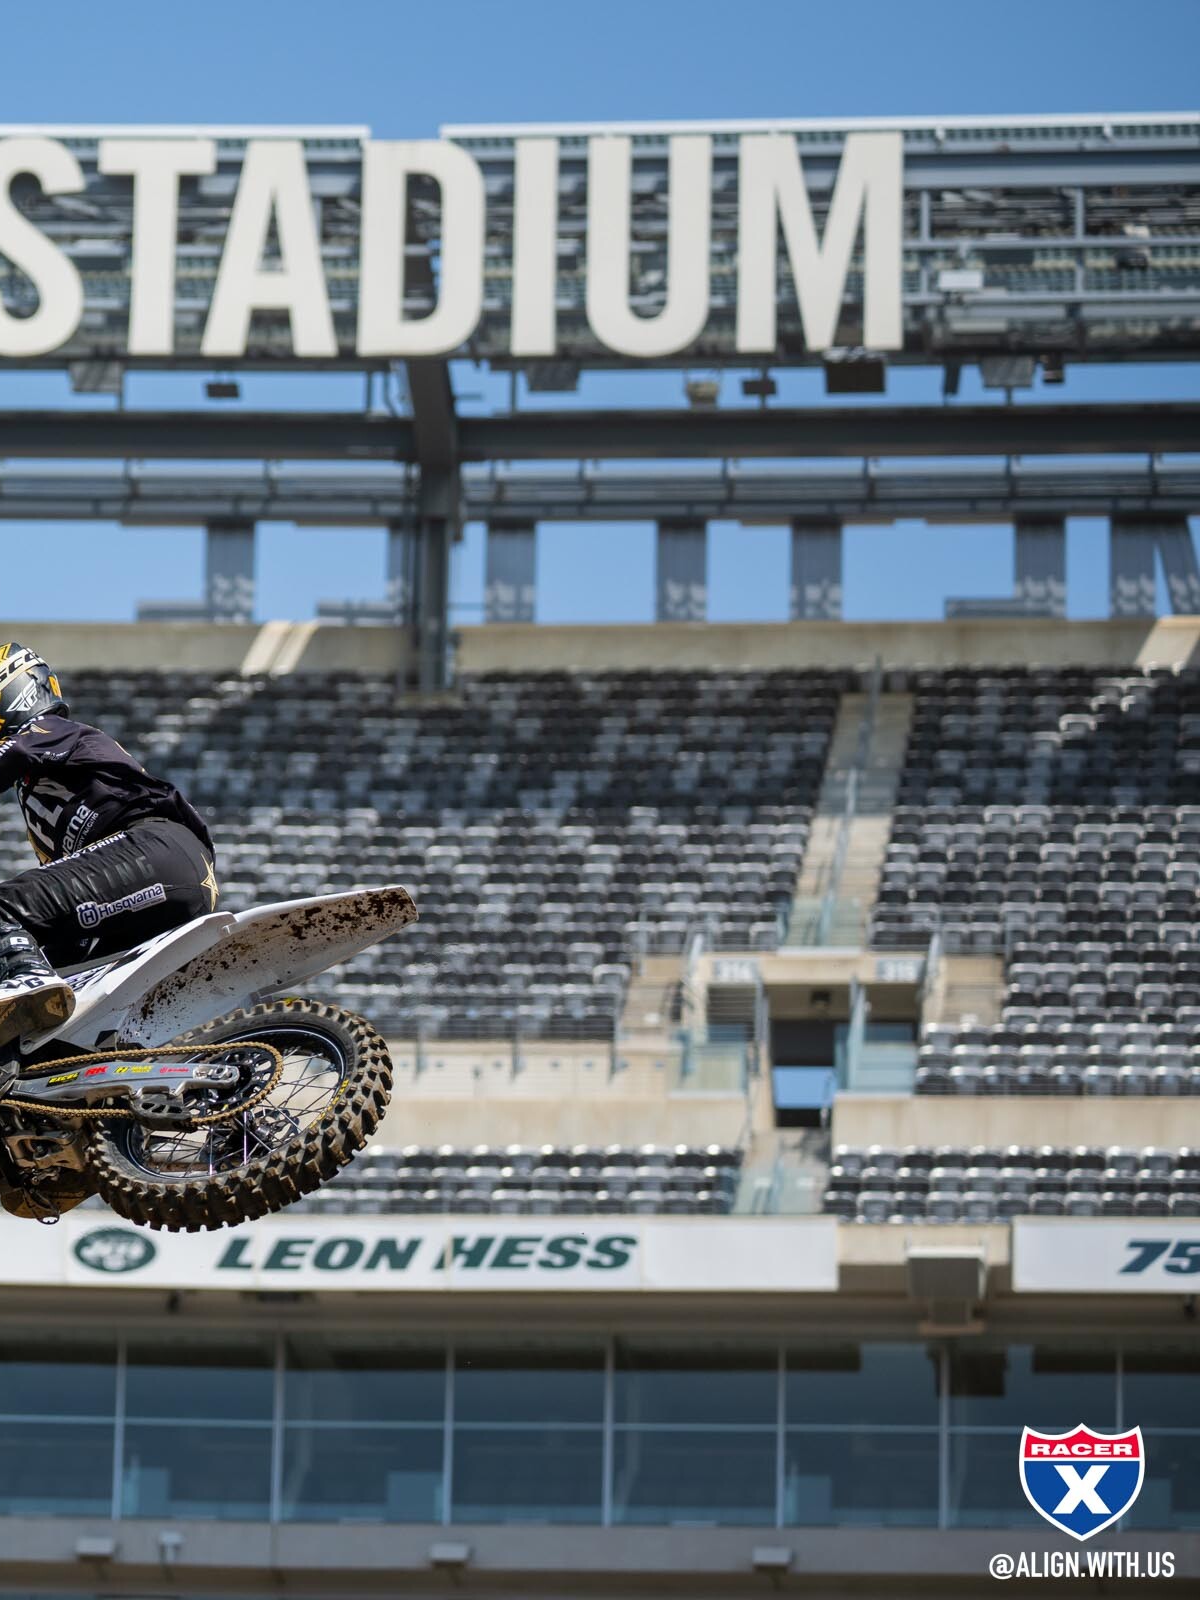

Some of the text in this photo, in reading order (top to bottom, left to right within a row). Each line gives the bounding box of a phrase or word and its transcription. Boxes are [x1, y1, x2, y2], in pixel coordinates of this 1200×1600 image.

[87, 832, 127, 853] DRINK
[100, 884, 163, 918] Husqvarna
[215, 1236, 421, 1271] LEON
[433, 1235, 638, 1270] HESS
[1118, 1239, 1200, 1275] 75
